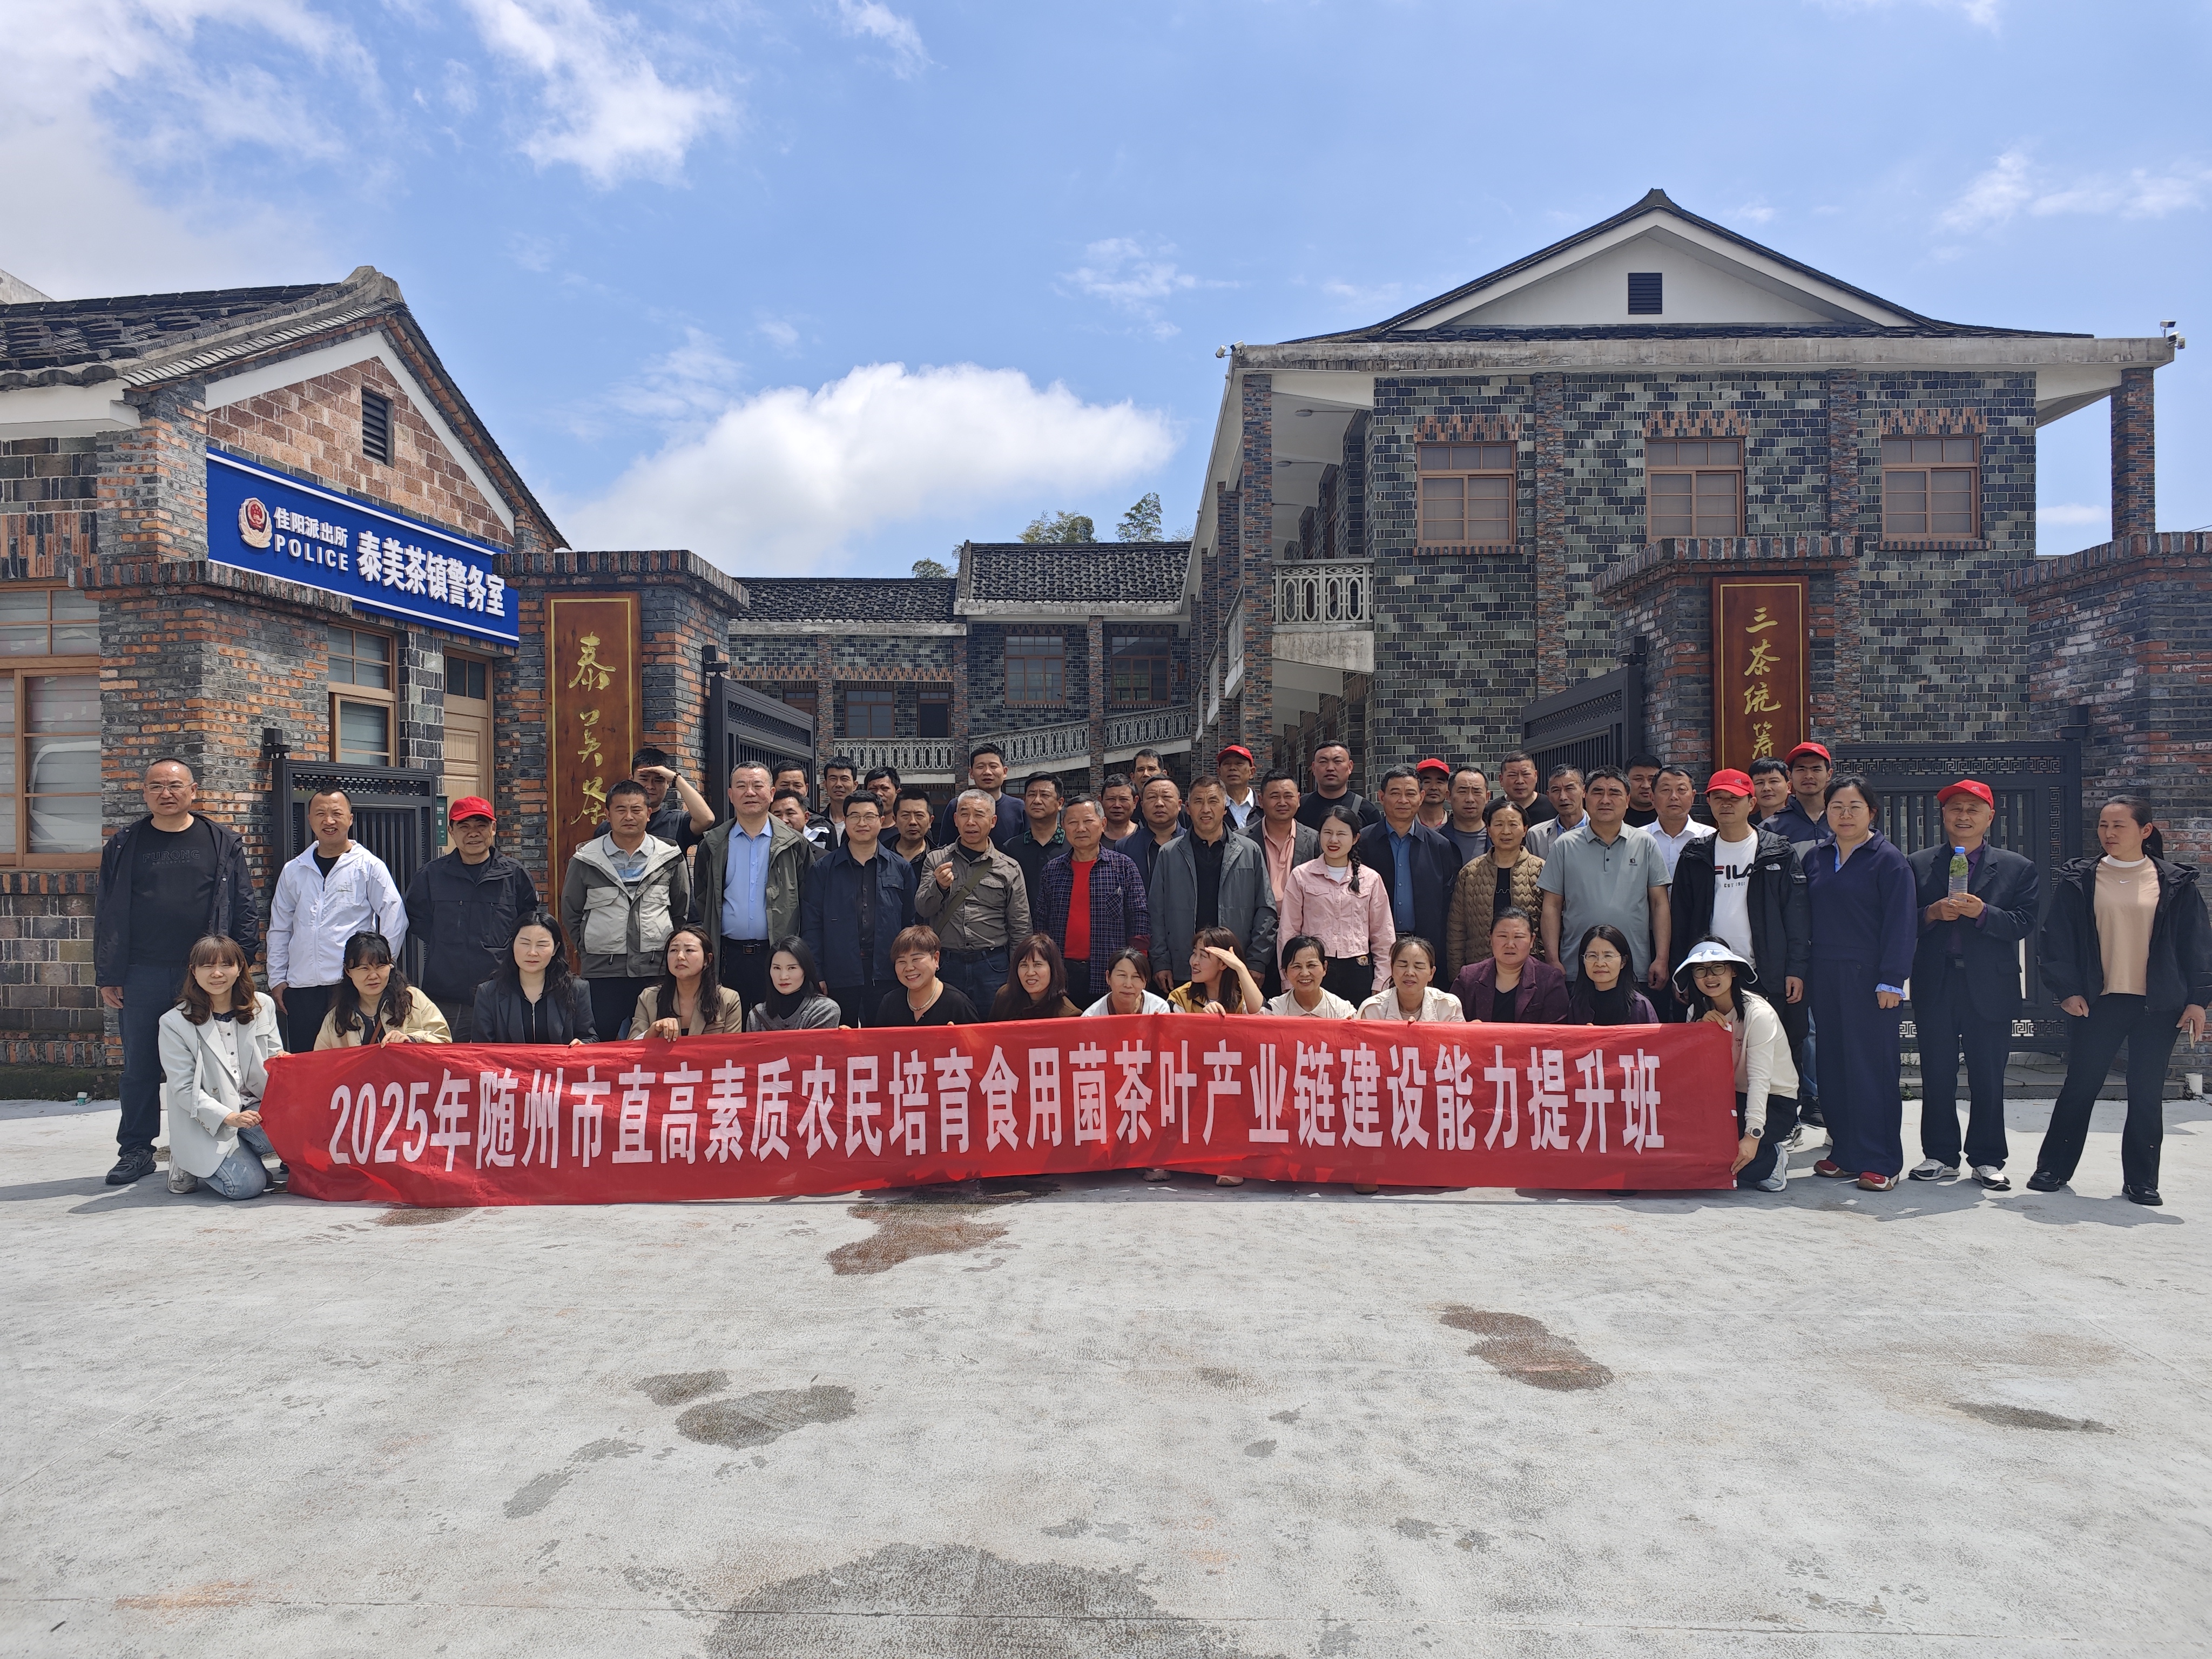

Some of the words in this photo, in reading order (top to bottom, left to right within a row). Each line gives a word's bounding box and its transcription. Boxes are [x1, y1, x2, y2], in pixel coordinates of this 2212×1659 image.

[273, 506, 348, 549] 佳阳派出所
[274, 534, 349, 571] POLICE
[356, 530, 505, 617] 泰美茶镇警务室
[1744, 606, 1782, 759] 三茶统筹
[143, 849, 200, 863] FURONG
[328, 1039, 1664, 1171] 2025年随州市直高素质农民培育食用菌茶叶产业链建设能力提升班
